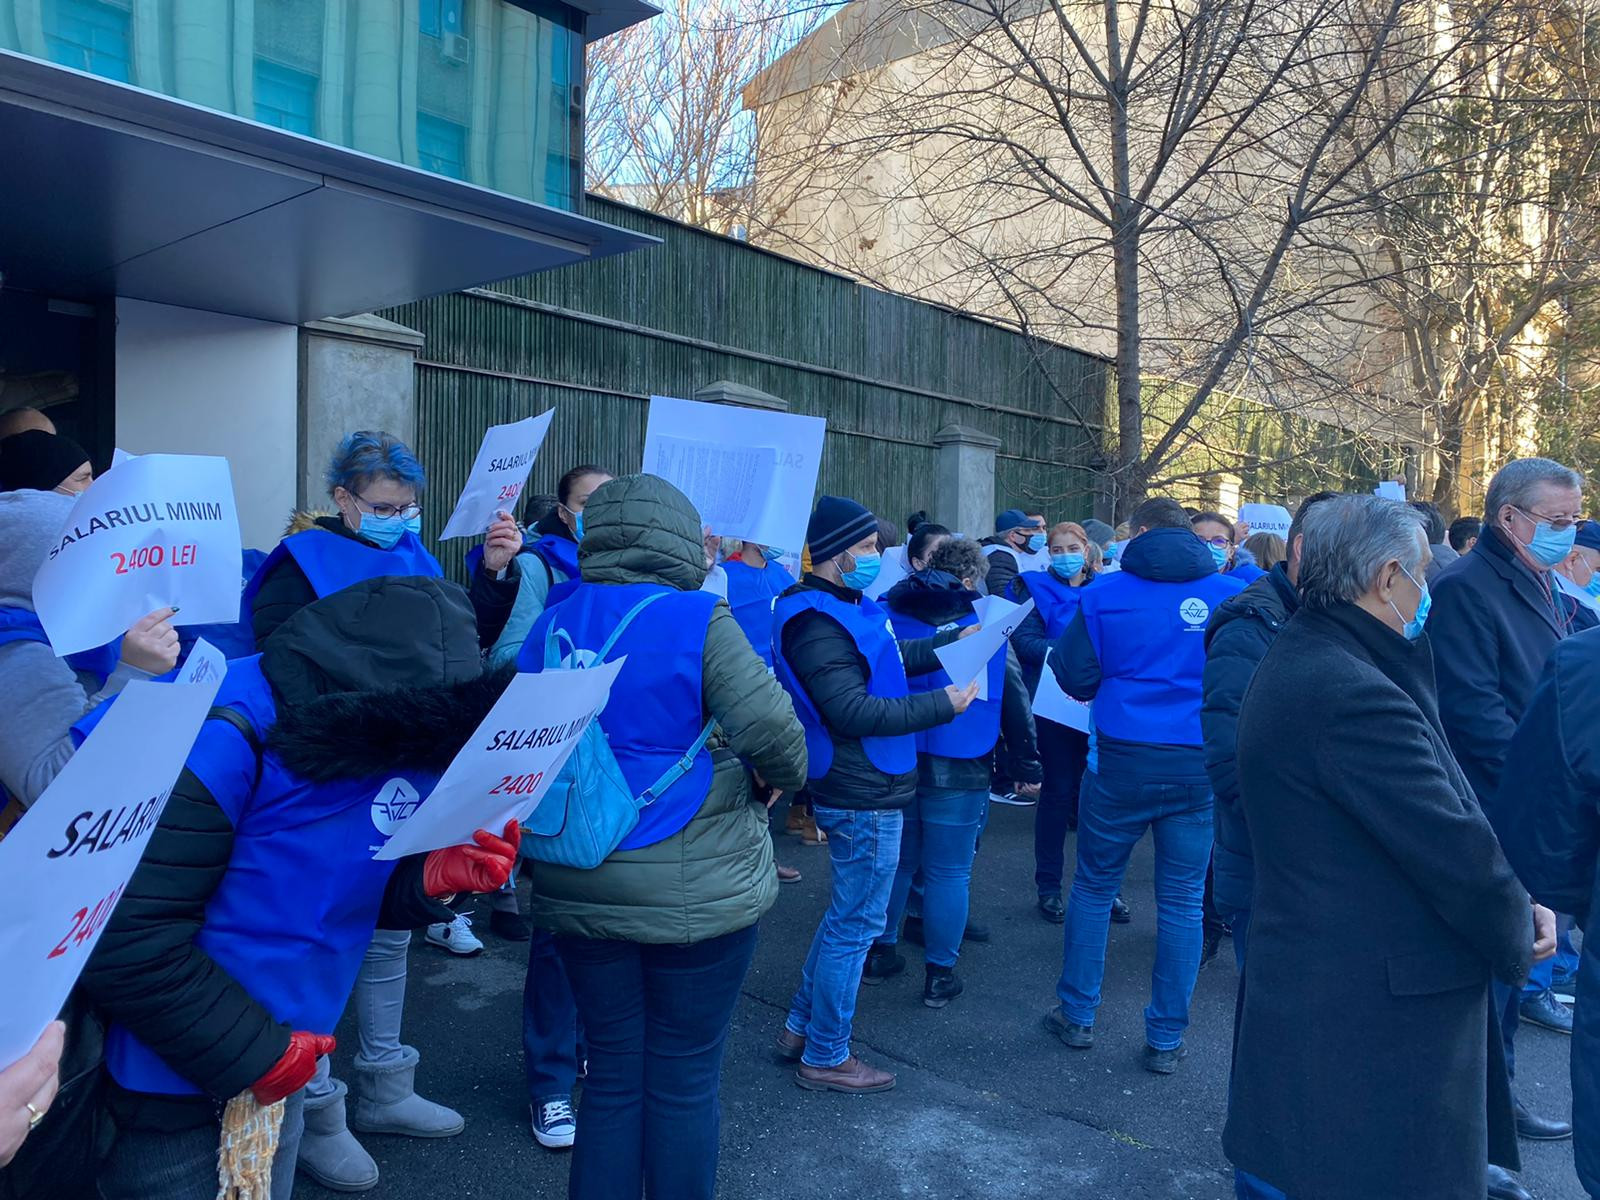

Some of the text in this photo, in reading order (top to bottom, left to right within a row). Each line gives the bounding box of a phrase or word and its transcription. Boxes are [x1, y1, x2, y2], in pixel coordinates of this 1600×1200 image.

[49, 502, 222, 560] SALARIUL MINIM
[110, 544, 197, 575] 2400 LEI
[486, 723, 567, 751] SALARIUL
[488, 771, 544, 795] 2400
